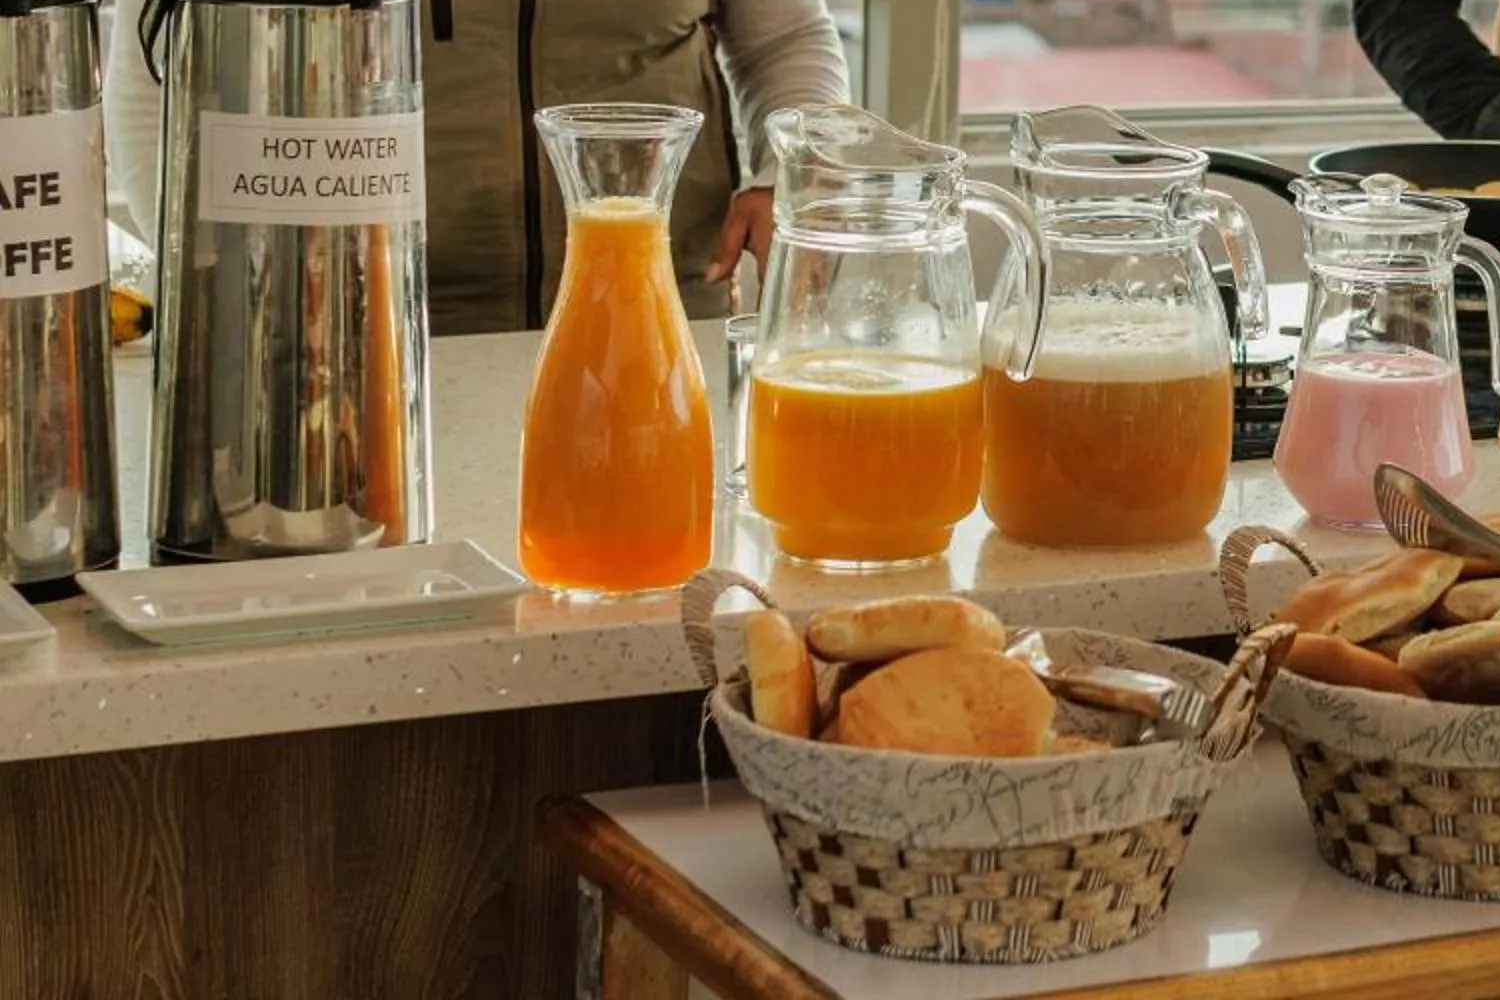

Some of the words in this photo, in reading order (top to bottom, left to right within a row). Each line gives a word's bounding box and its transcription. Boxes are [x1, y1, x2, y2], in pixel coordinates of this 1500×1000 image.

[262, 137, 317, 160] HOT
[324, 137, 398, 160] WATER
[232, 172, 307, 197] AGUA
[315, 172, 412, 198] CALIENTE
[0, 236, 74, 277] FFE
